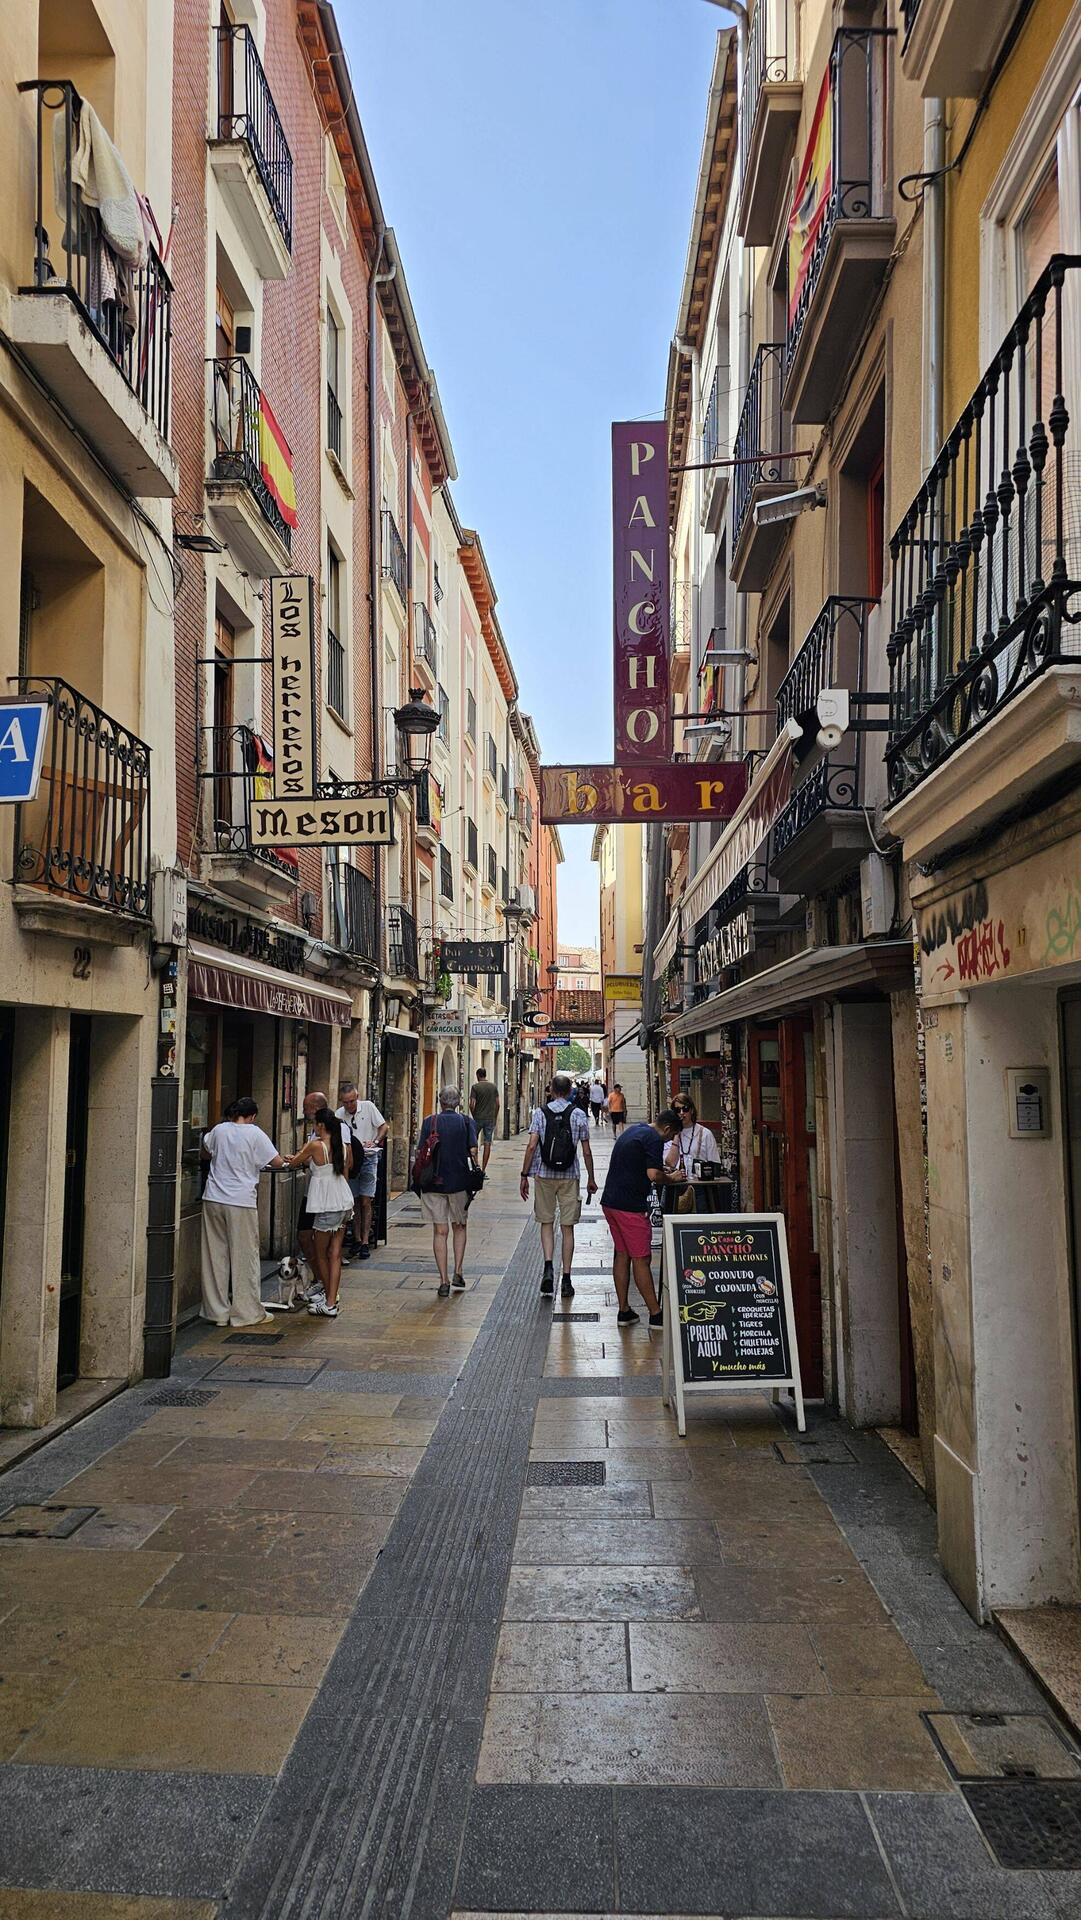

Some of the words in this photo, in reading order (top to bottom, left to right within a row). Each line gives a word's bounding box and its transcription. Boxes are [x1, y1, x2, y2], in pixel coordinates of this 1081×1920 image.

[626, 442, 660, 744] PANCHO
[280, 581, 303, 638] Los
[560, 771, 725, 815] bar
[72, 946, 92, 981] 22
[426, 1025, 462, 1033] CARACOLES
[703, 1244, 752, 1255] PANCHO
[690, 1255, 722, 1263] PINCHOS
[724, 1254, 729, 1262] Y
[732, 1253, 769, 1262] RACIONES
[708, 1270, 754, 1280] COJONUDO
[715, 1283, 757, 1293] COJONUDA
[737, 1305, 775, 1313] CROQUETAS
[739, 1320, 763, 1328] TIGRES
[689, 1324, 728, 1342] PRUEBA
[739, 1338, 780, 1347] CHULETILLAS
[740, 1347, 774, 1356] MOLLEJAS
[711, 1360, 719, 1371] Y
[719, 1360, 746, 1371] mucho
[748, 1361, 766, 1371] más
